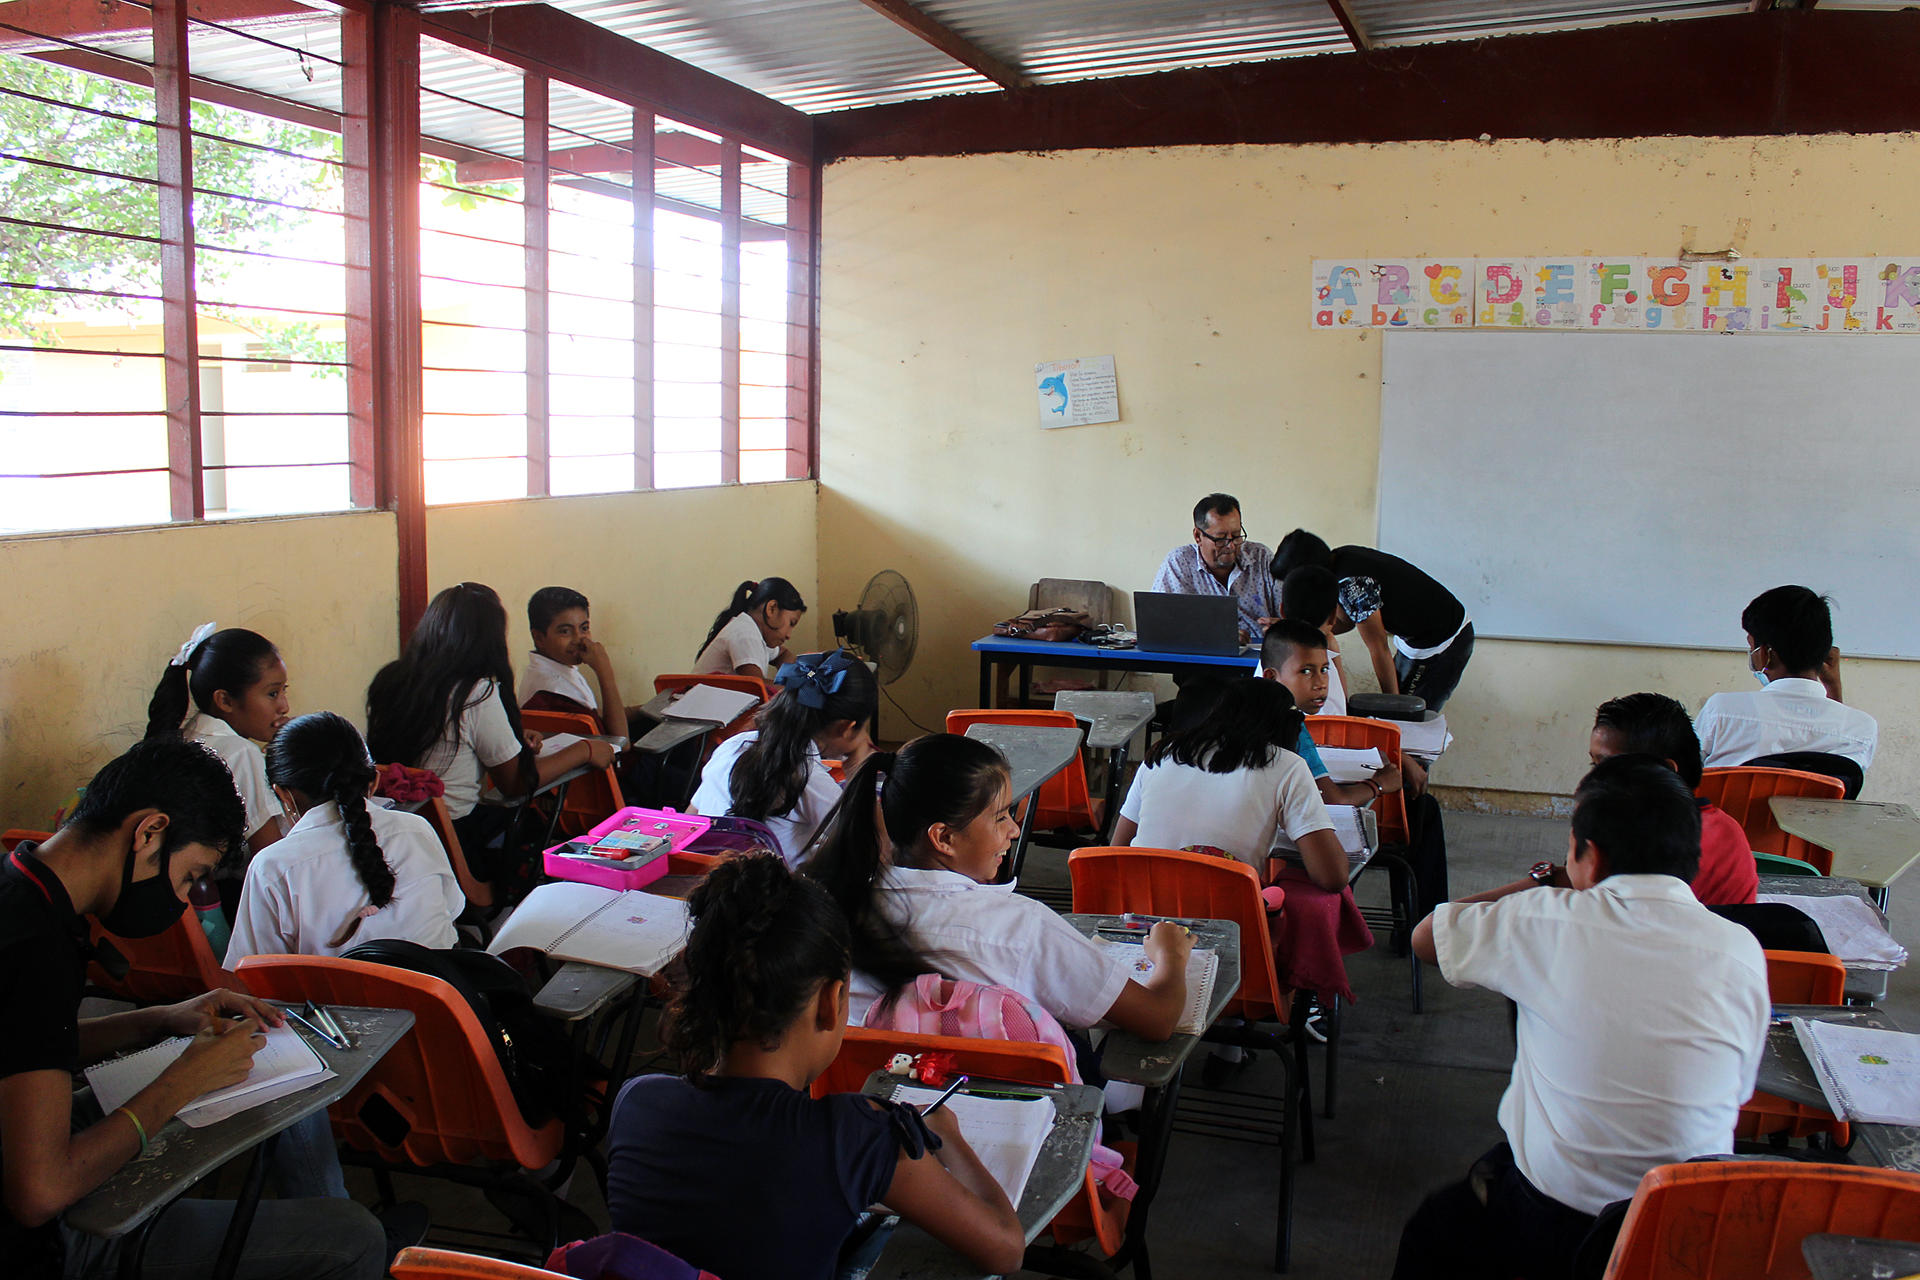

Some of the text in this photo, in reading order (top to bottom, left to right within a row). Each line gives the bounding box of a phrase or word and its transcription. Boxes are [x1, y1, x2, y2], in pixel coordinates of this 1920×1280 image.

[1320, 265, 1358, 306] A
[1378, 265, 1410, 305] B
[1430, 265, 1463, 305] C
[1487, 266, 1522, 304] D
[1545, 264, 1574, 304] E
[1600, 264, 1631, 305] F
[1652, 266, 1690, 307] G
[1706, 265, 1749, 307] H
[1827, 265, 1858, 309] J
[1316, 303, 1894, 331] a b c d e f g h i j k
